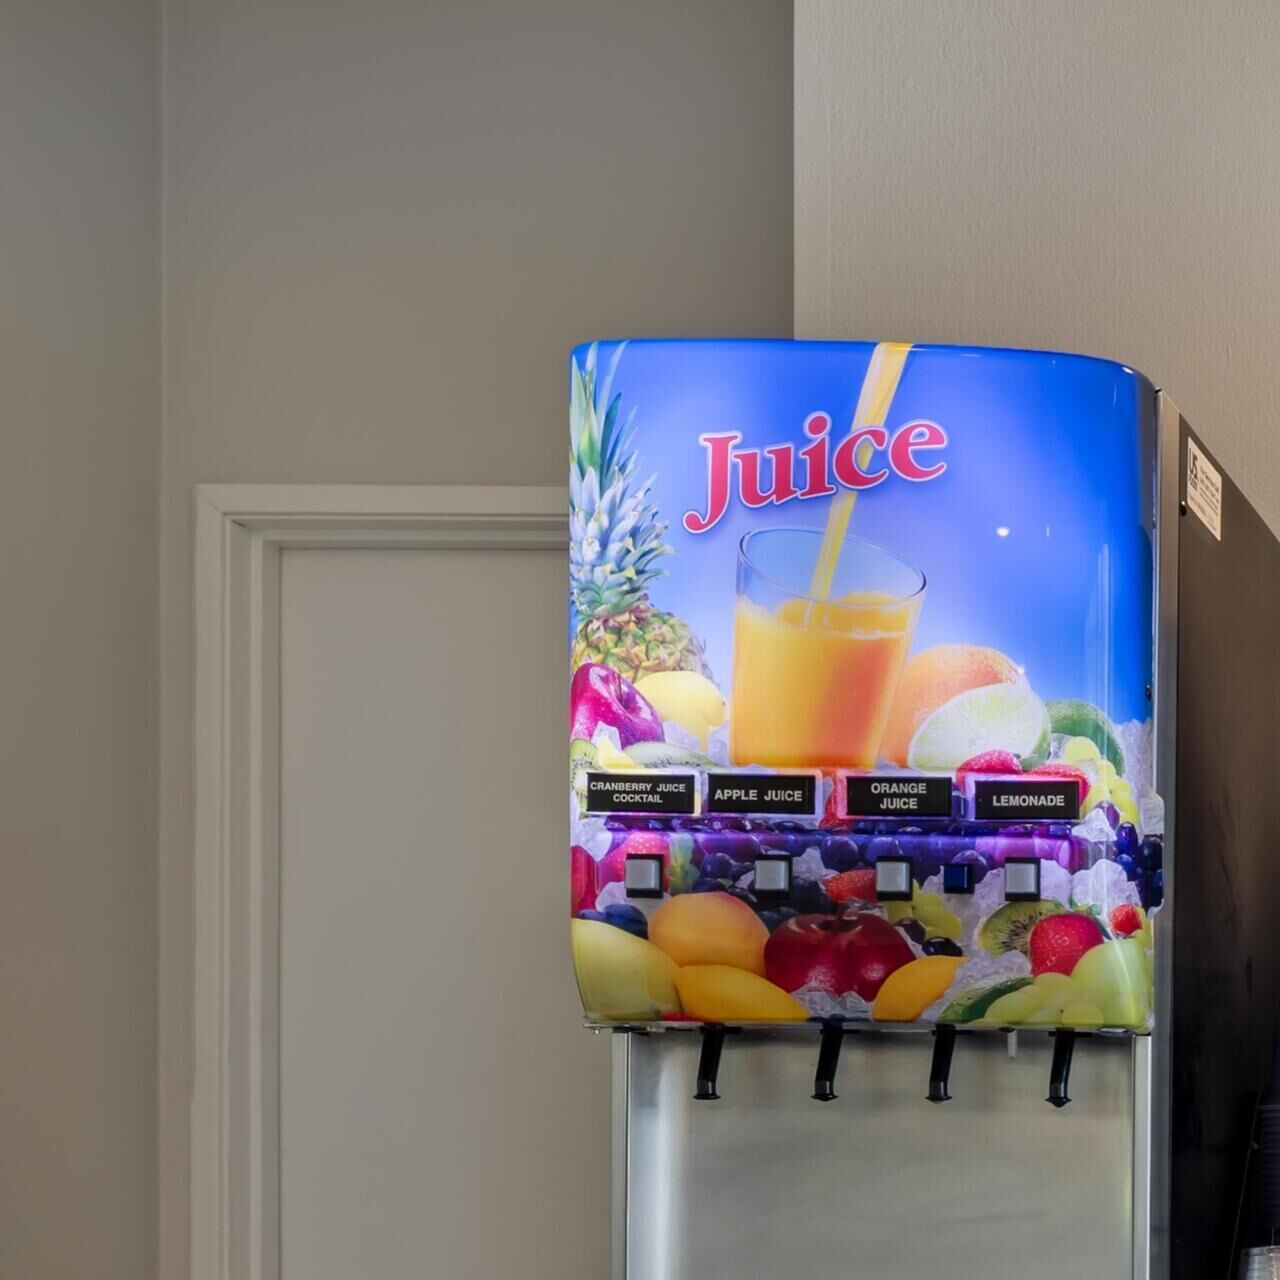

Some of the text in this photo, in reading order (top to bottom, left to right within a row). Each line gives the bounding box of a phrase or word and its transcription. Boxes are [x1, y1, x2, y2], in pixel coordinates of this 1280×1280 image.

[683, 411, 948, 533] Juice
[590, 782, 686, 792] CRANBERRY JUICE
[871, 783, 927, 793] ORANGE
[612, 793, 663, 803] COCKTAIL
[714, 789, 803, 801] APPLE JUICE
[993, 795, 1065, 806] LEMONADE
[880, 798, 918, 809] JUICE
